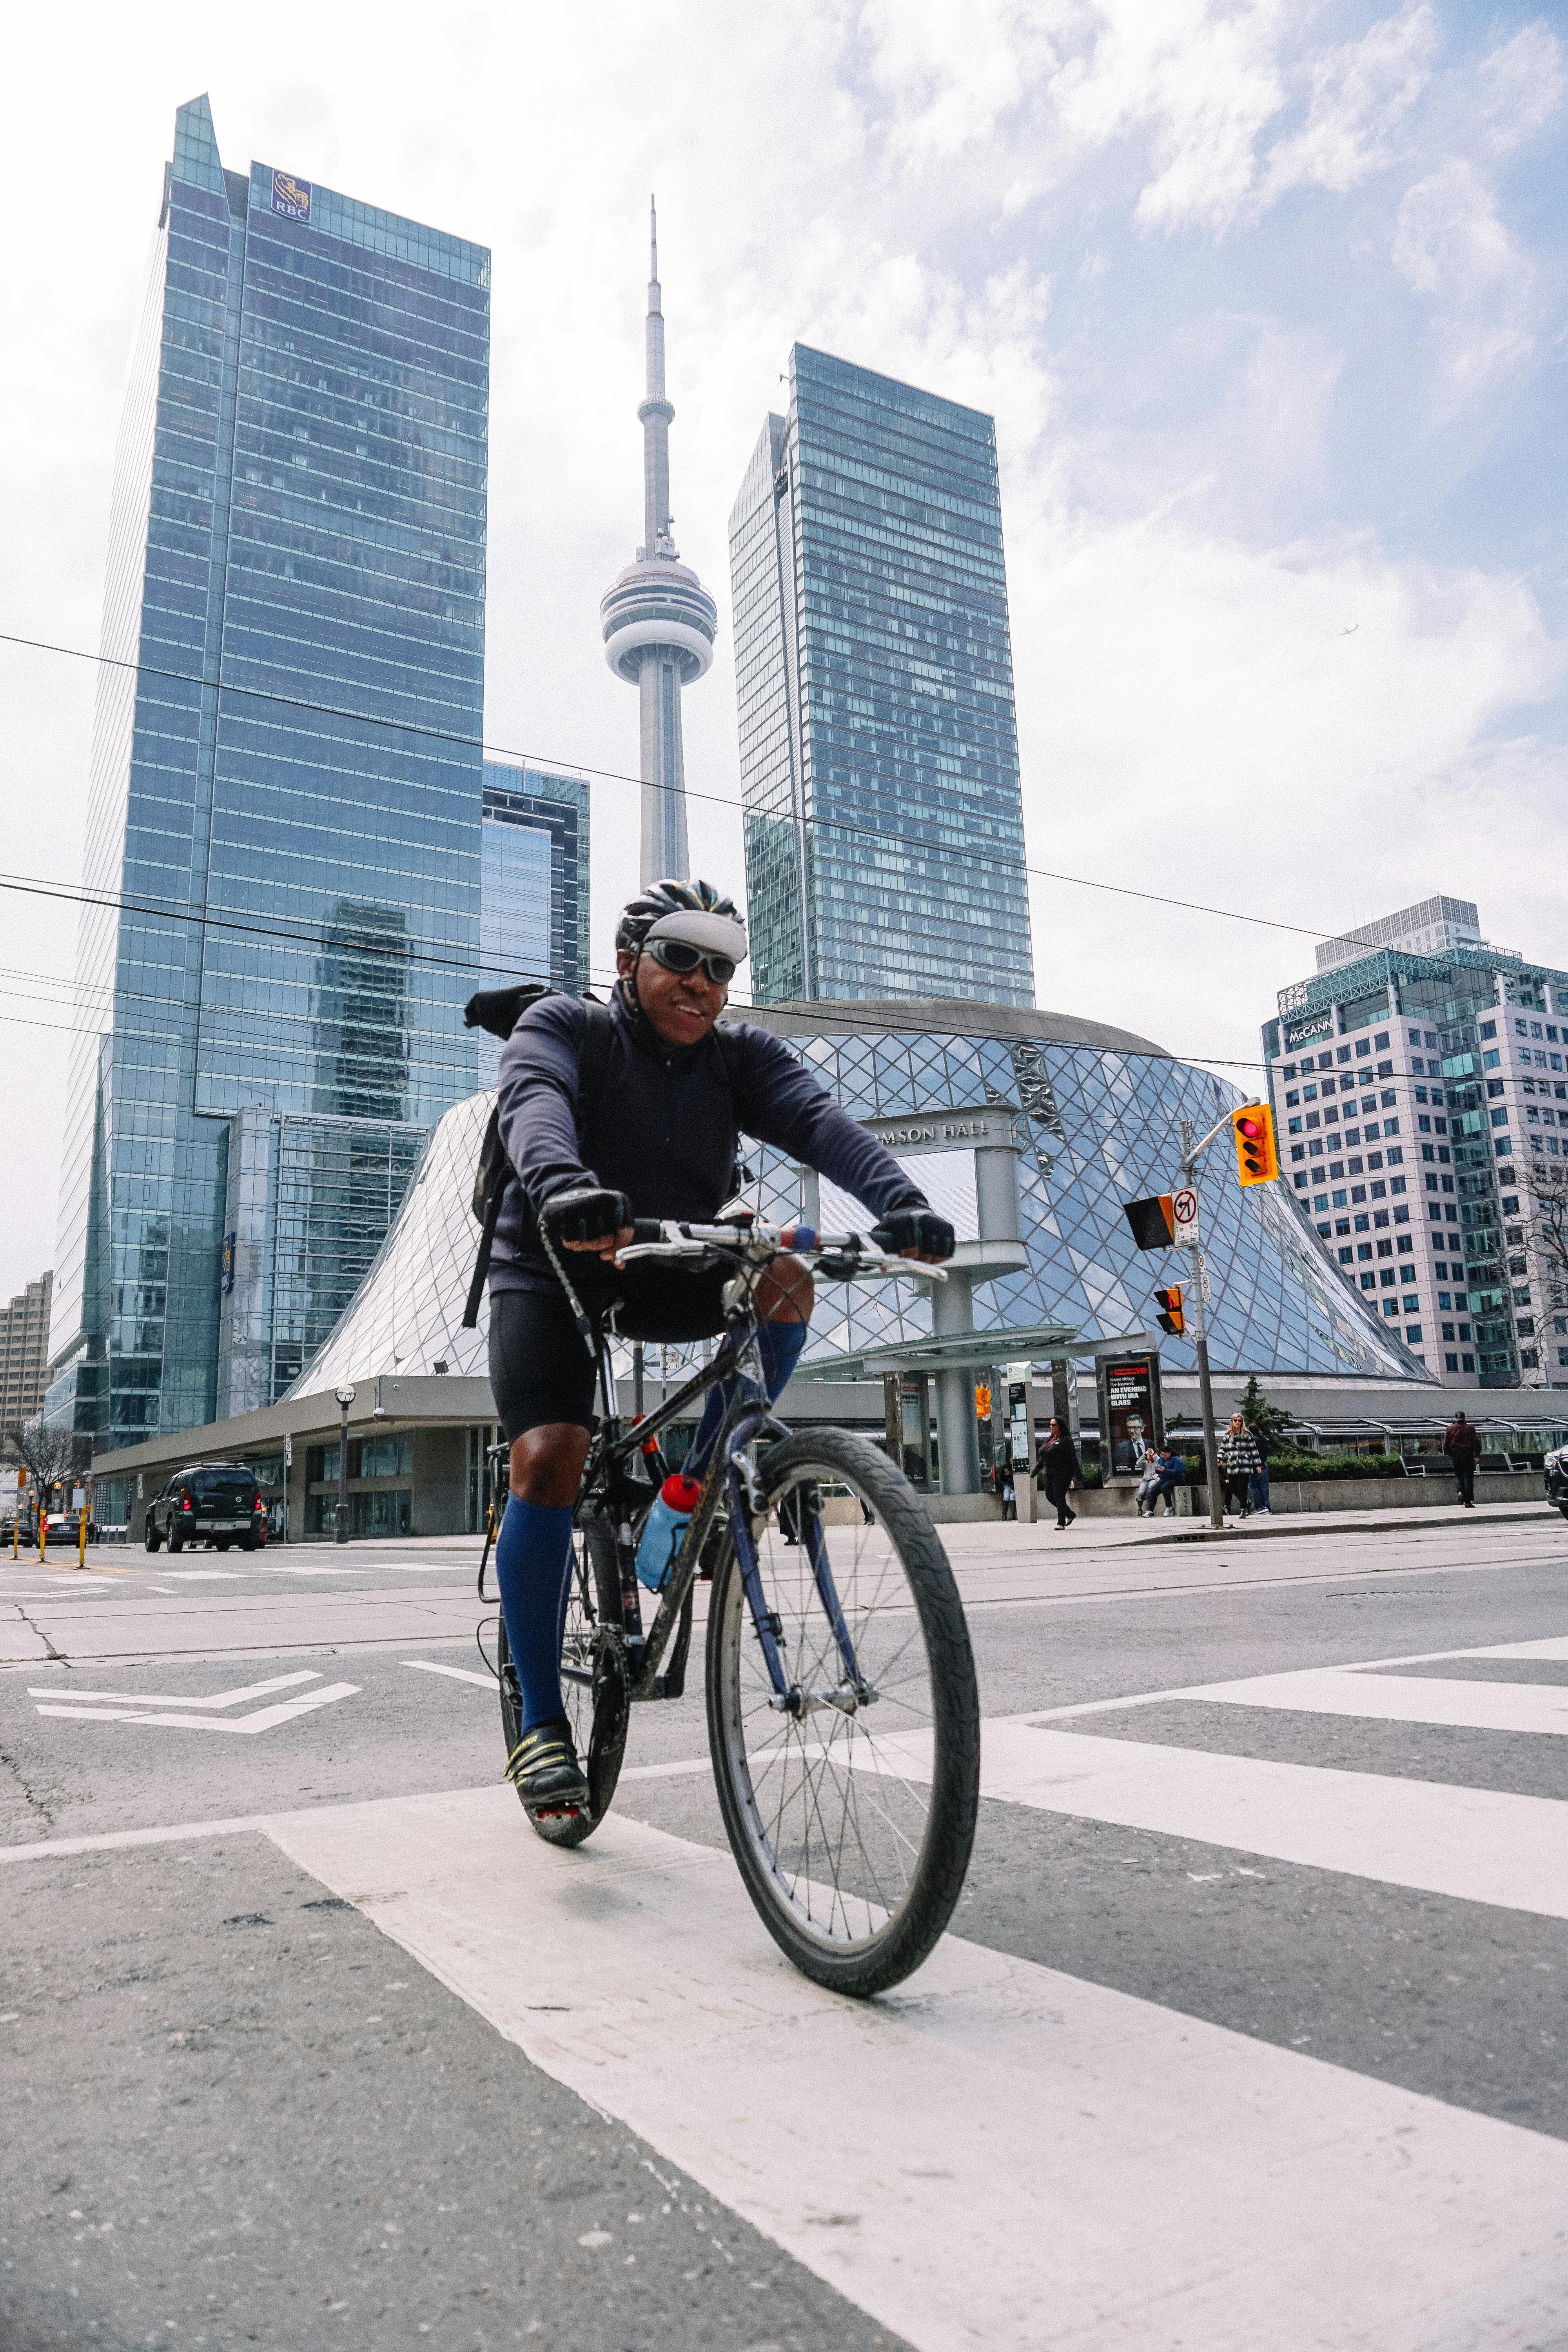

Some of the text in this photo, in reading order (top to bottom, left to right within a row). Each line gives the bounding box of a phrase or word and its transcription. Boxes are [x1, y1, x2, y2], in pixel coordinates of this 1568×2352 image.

[276, 200, 306, 219] RBC
[1289, 1018, 1333, 1043] McCANN
[943, 1121, 988, 1138] HALL
